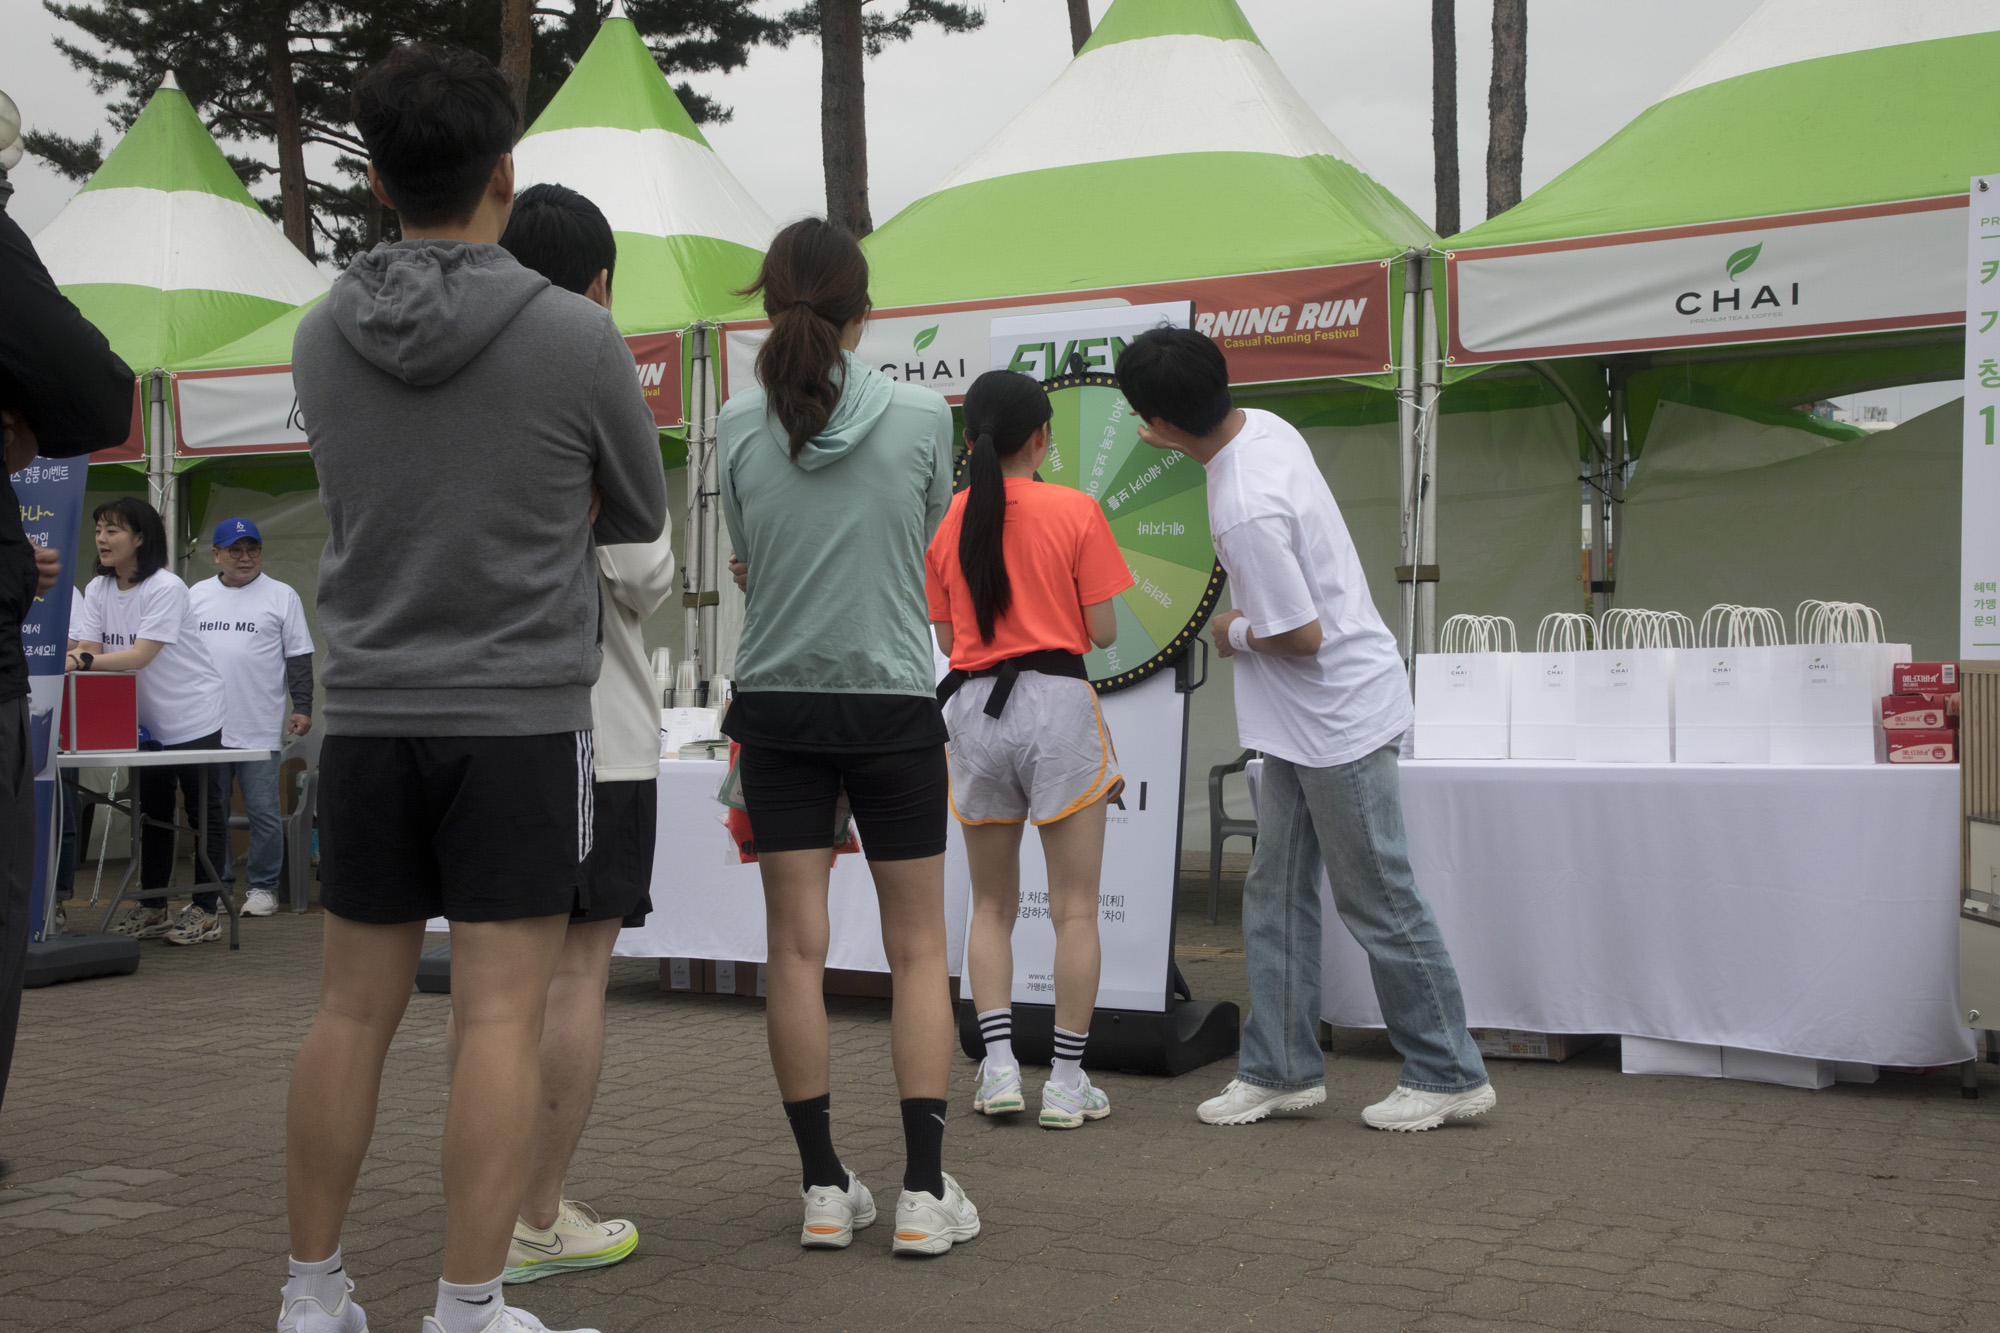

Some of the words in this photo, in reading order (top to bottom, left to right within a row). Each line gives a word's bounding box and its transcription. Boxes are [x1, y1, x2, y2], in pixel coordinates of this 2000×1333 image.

[1675, 282, 1799, 316] CHAI
[1194, 304, 1291, 339] RNING
[1296, 297, 1368, 331] RUN
[1751, 311, 1784, 319] COFFEE
[1223, 338, 1261, 348] Casual
[1264, 332, 1311, 345] Running
[1314, 327, 1359, 342] Festival
[880, 358, 965, 382] CHAI
[1108, 397, 1125, 423] 차이
[1099, 426, 1116, 450] 손목
[24, 466, 40, 484] 경품
[42, 465, 69, 482] 이벤트
[1091, 452, 1108, 478] 보호
[1129, 464, 1162, 494] 쉐이커
[1106, 488, 1130, 511] 보틀
[1137, 521, 1185, 536] 에너지바
[1140, 578, 1173, 609] 격려의
[1974, 582, 1997, 593] 혜택
[1974, 599, 1997, 610] 가맹
[22, 624, 41, 634] 에서
[200, 621, 231, 631] Hello
[1974, 615, 1997, 627] 문의
[23, 644, 56, 657] 주세요!!
[1104, 646, 1122, 672] 차이
[1902, 675, 1930, 683] 에너지바
[1026, 982, 1054, 992] 가맹문의
